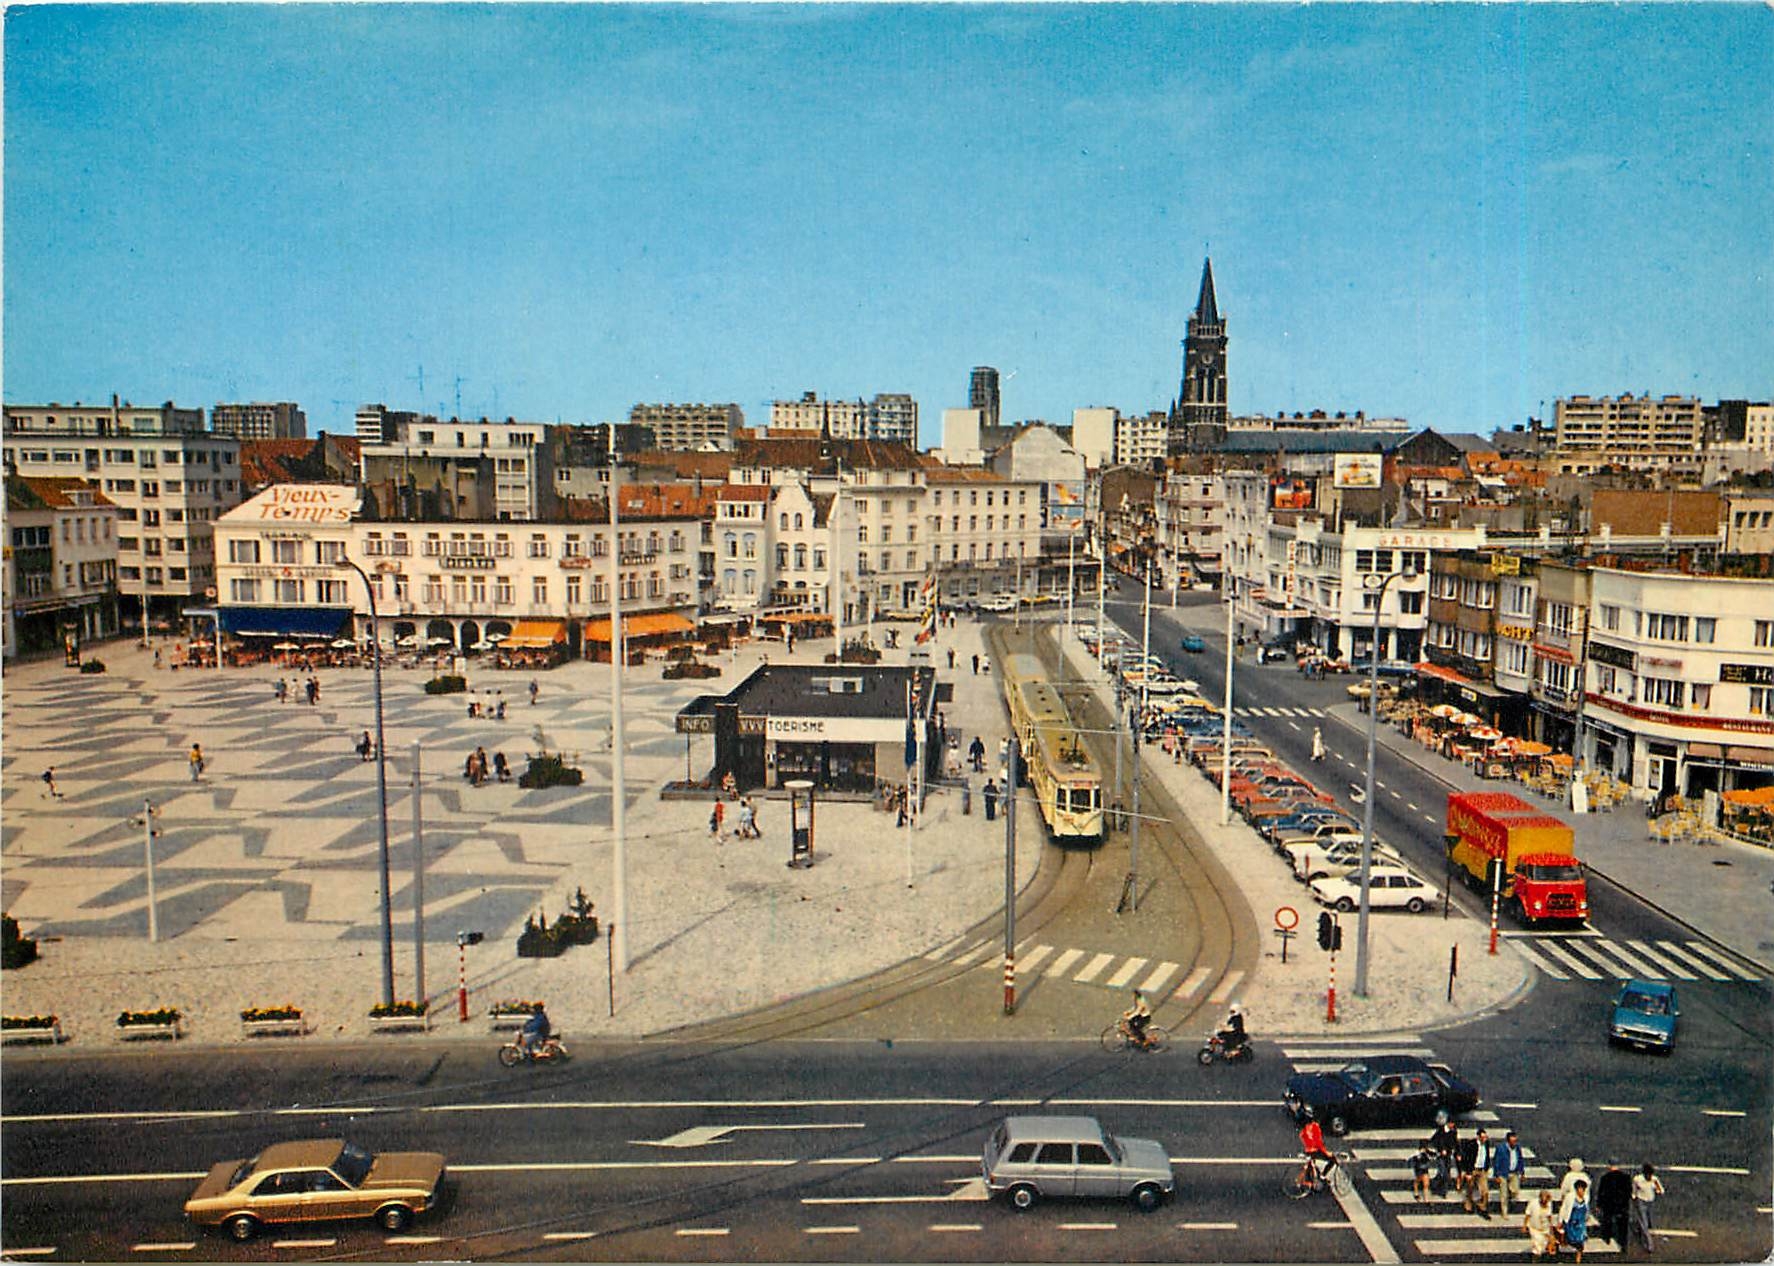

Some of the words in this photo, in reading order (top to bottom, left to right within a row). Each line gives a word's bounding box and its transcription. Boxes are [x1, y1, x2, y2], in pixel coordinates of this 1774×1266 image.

[260, 503, 350, 523] Temps
[681, 718, 710, 730] INFO
[768, 720, 825, 733] TOERISME
